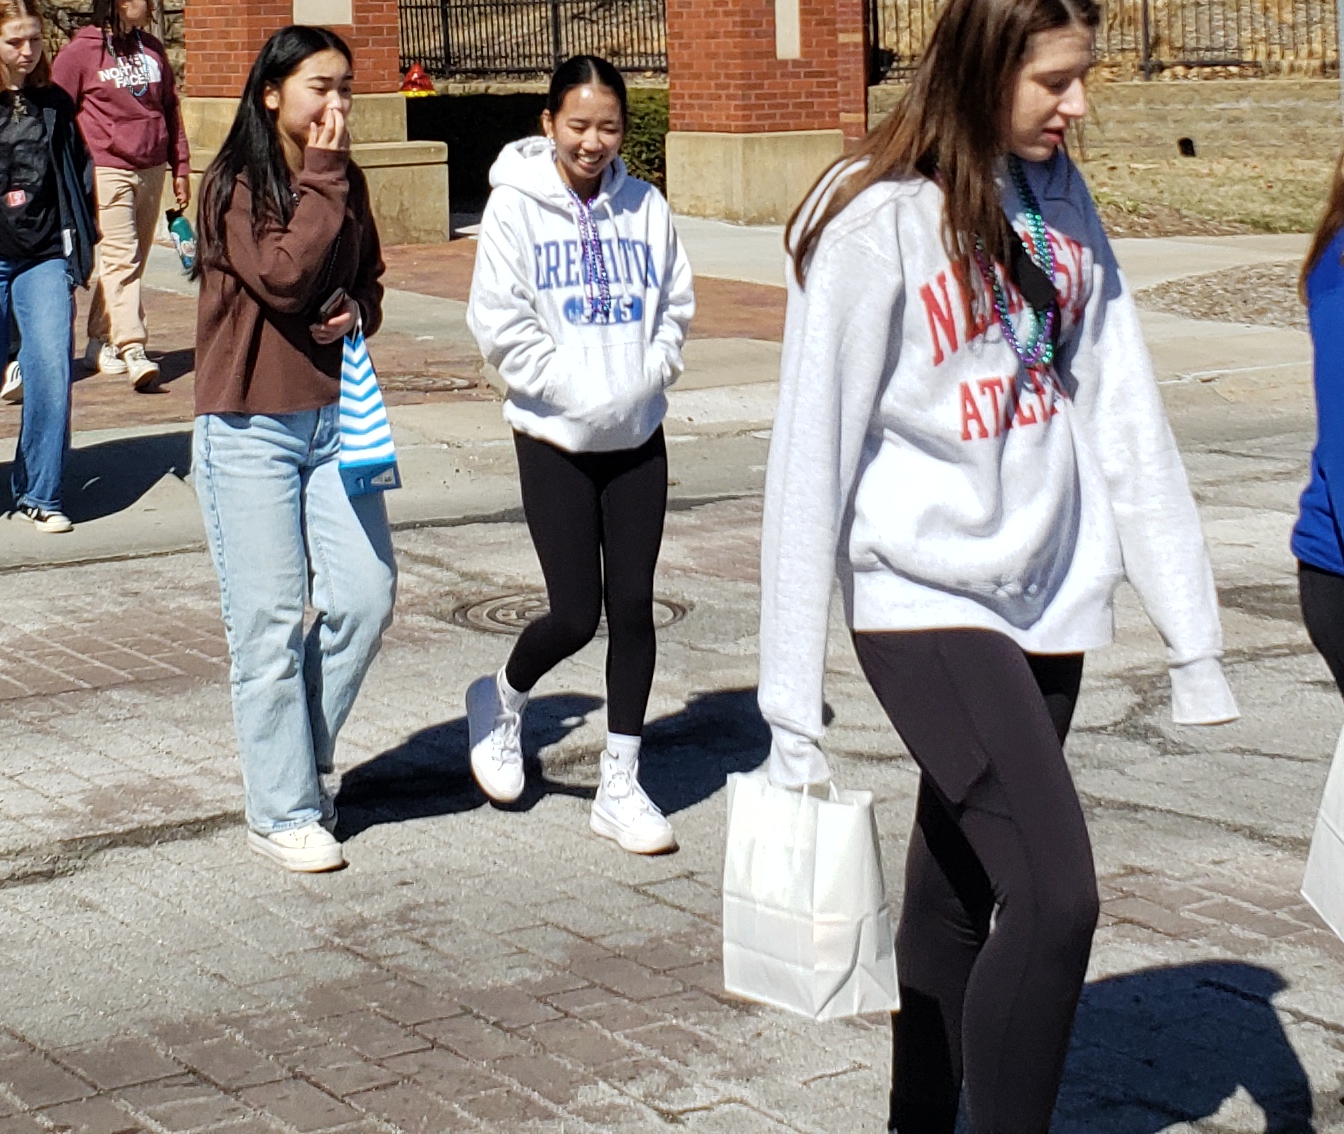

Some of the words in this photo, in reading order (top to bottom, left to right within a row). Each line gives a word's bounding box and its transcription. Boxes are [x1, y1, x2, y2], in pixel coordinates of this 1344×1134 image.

[98, 66, 144, 82] NORTH
[115, 74, 147, 89] FACE
[533, 238, 661, 291] CRETON
